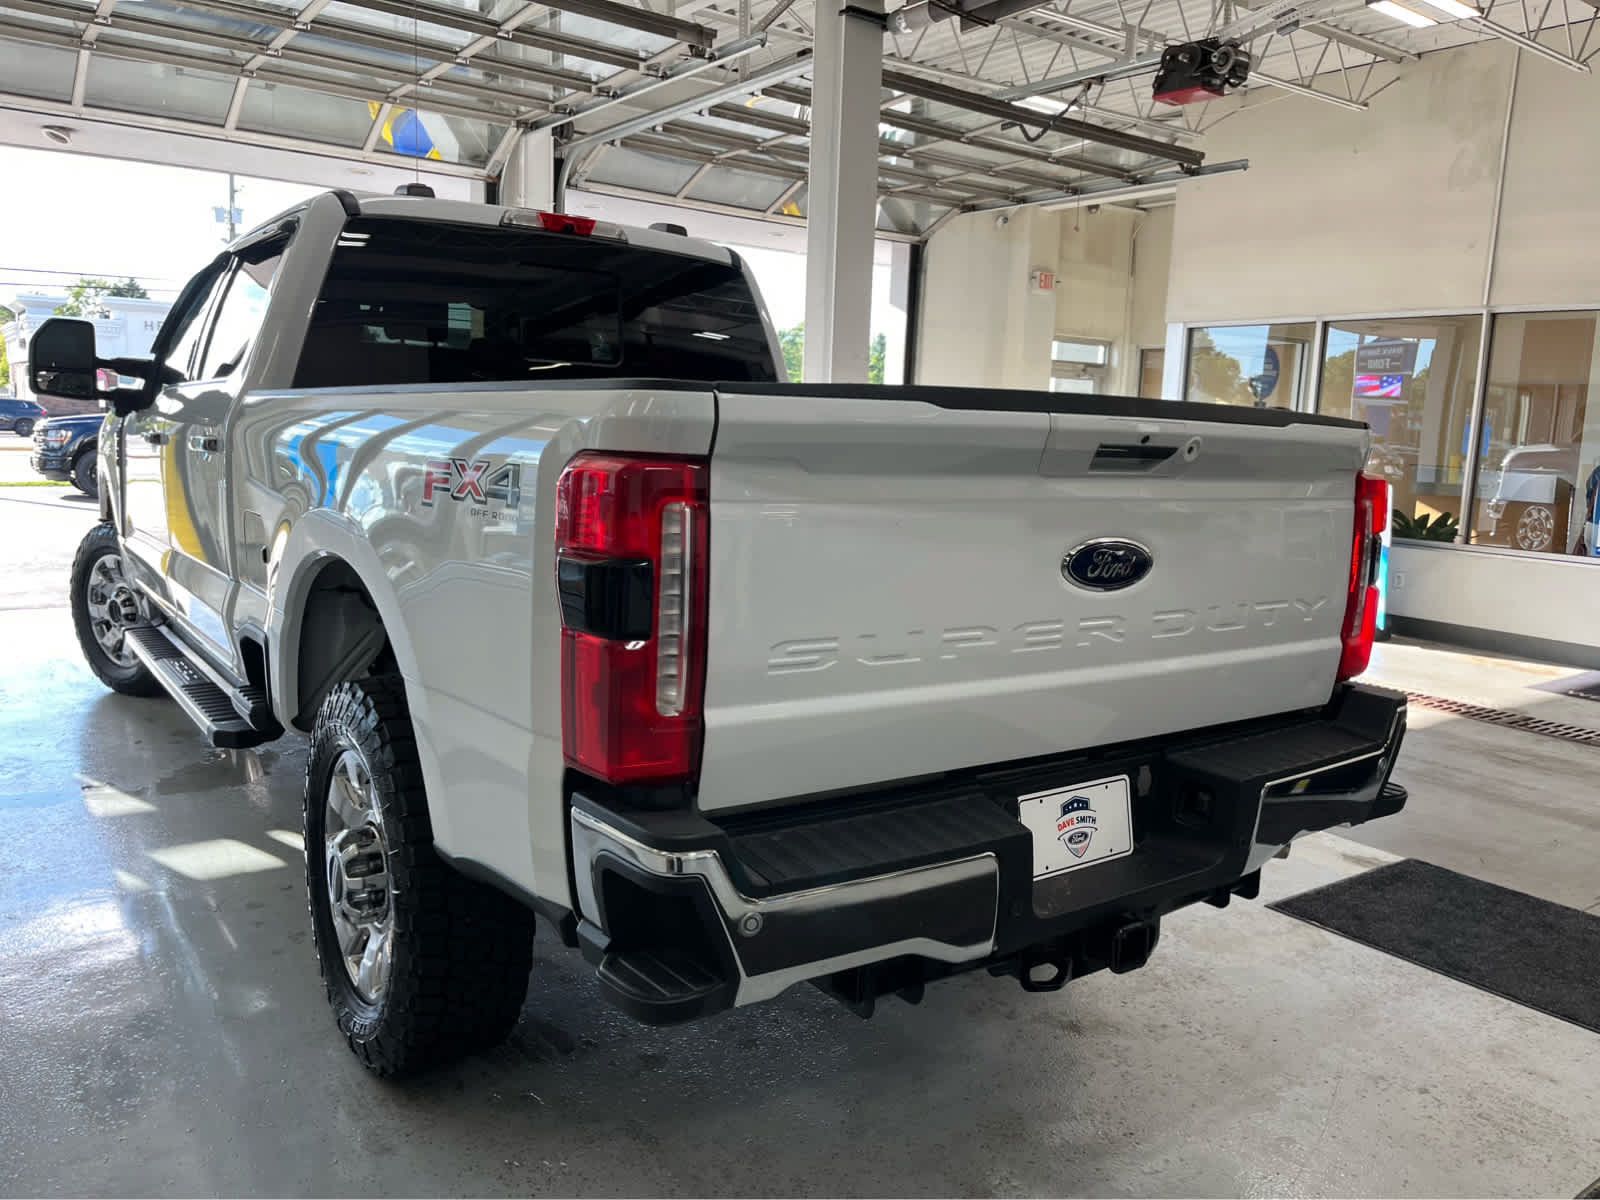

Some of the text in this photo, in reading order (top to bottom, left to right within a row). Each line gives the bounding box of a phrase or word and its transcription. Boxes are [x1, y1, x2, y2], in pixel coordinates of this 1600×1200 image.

[1039, 273, 1054, 288] EXIT
[421, 458, 520, 508] FX4
[470, 508, 489, 518] OFF
[1086, 548, 1136, 578] Ford
[767, 596, 1328, 676] SUPER DUTY
[1057, 815, 1097, 832] DAVE SMITH
